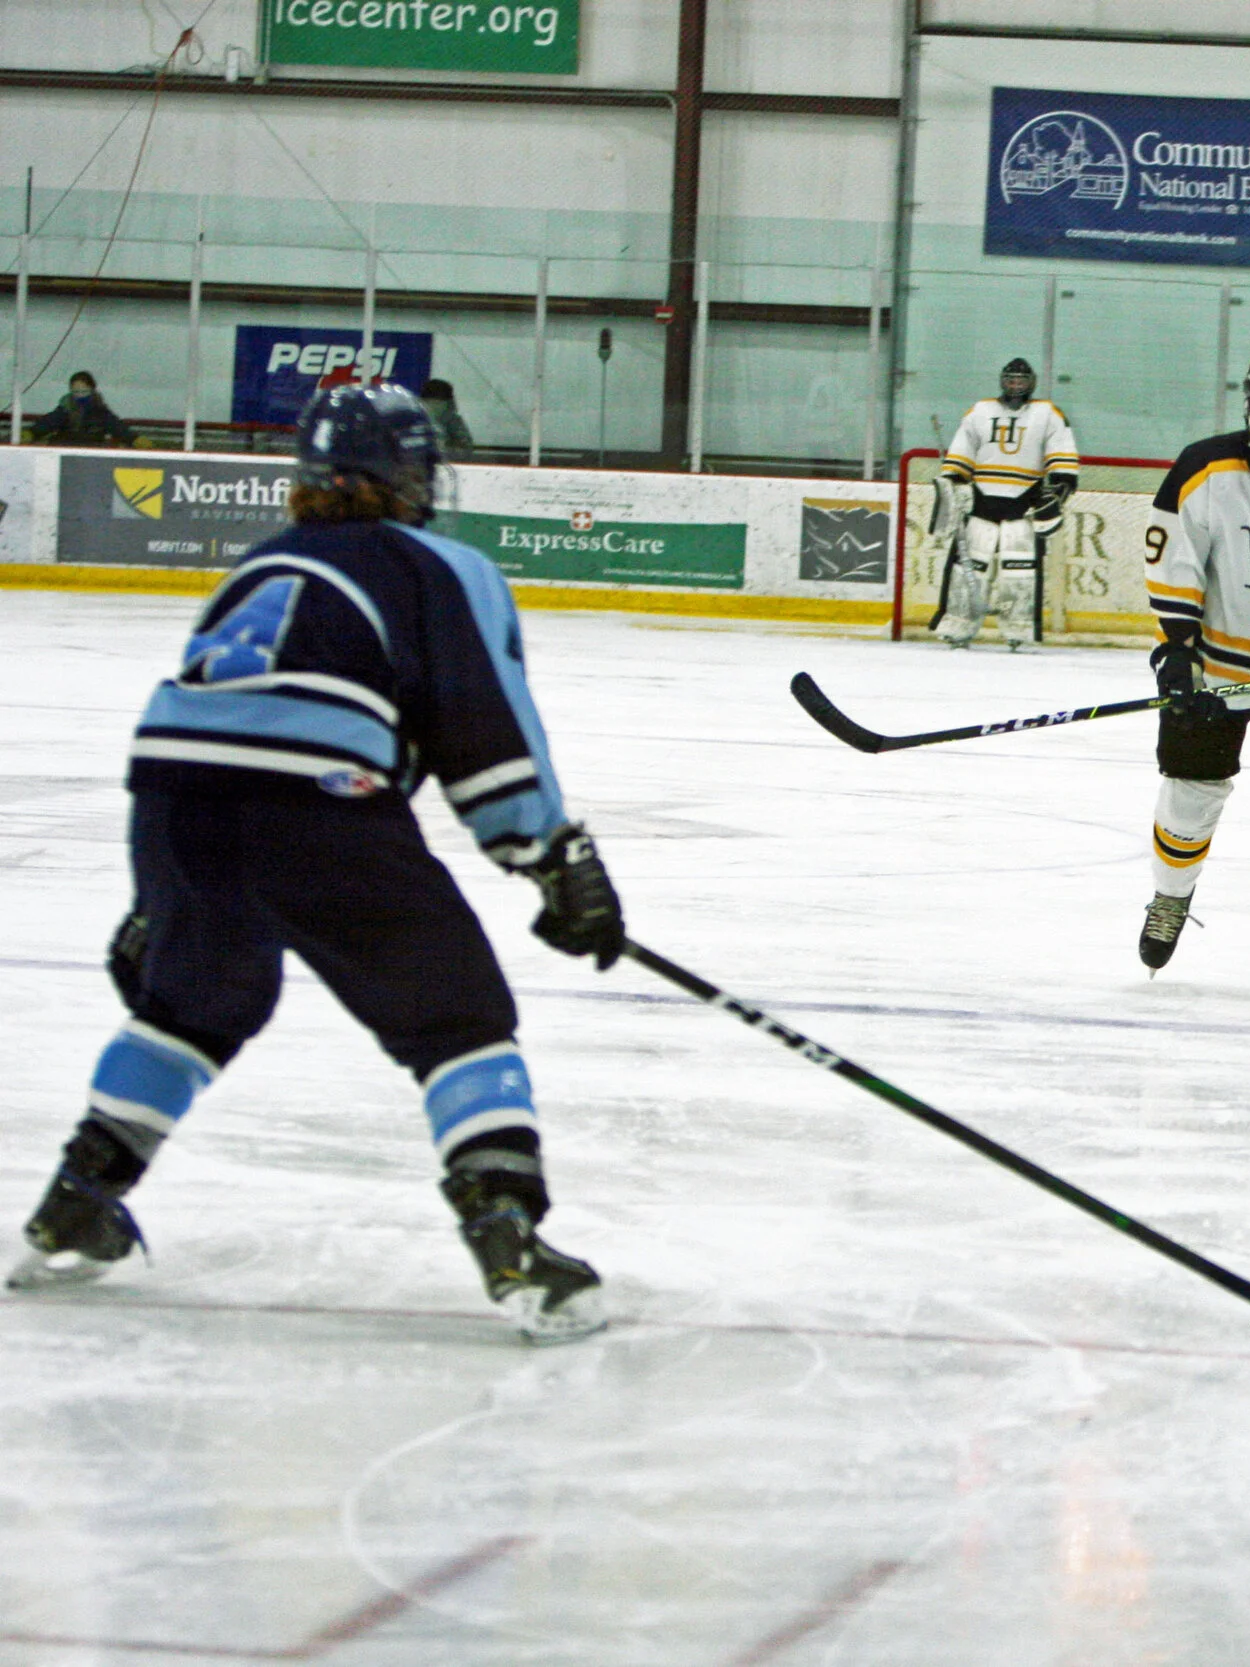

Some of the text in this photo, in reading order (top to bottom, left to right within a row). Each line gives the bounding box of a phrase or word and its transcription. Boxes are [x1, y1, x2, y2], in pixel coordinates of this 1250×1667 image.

[1138, 171, 1234, 201] National
[267, 343, 398, 378] PEPSI
[171, 474, 291, 507] Northfi
[499, 526, 665, 556] ExpressCare
[979, 709, 1077, 737] CCM
